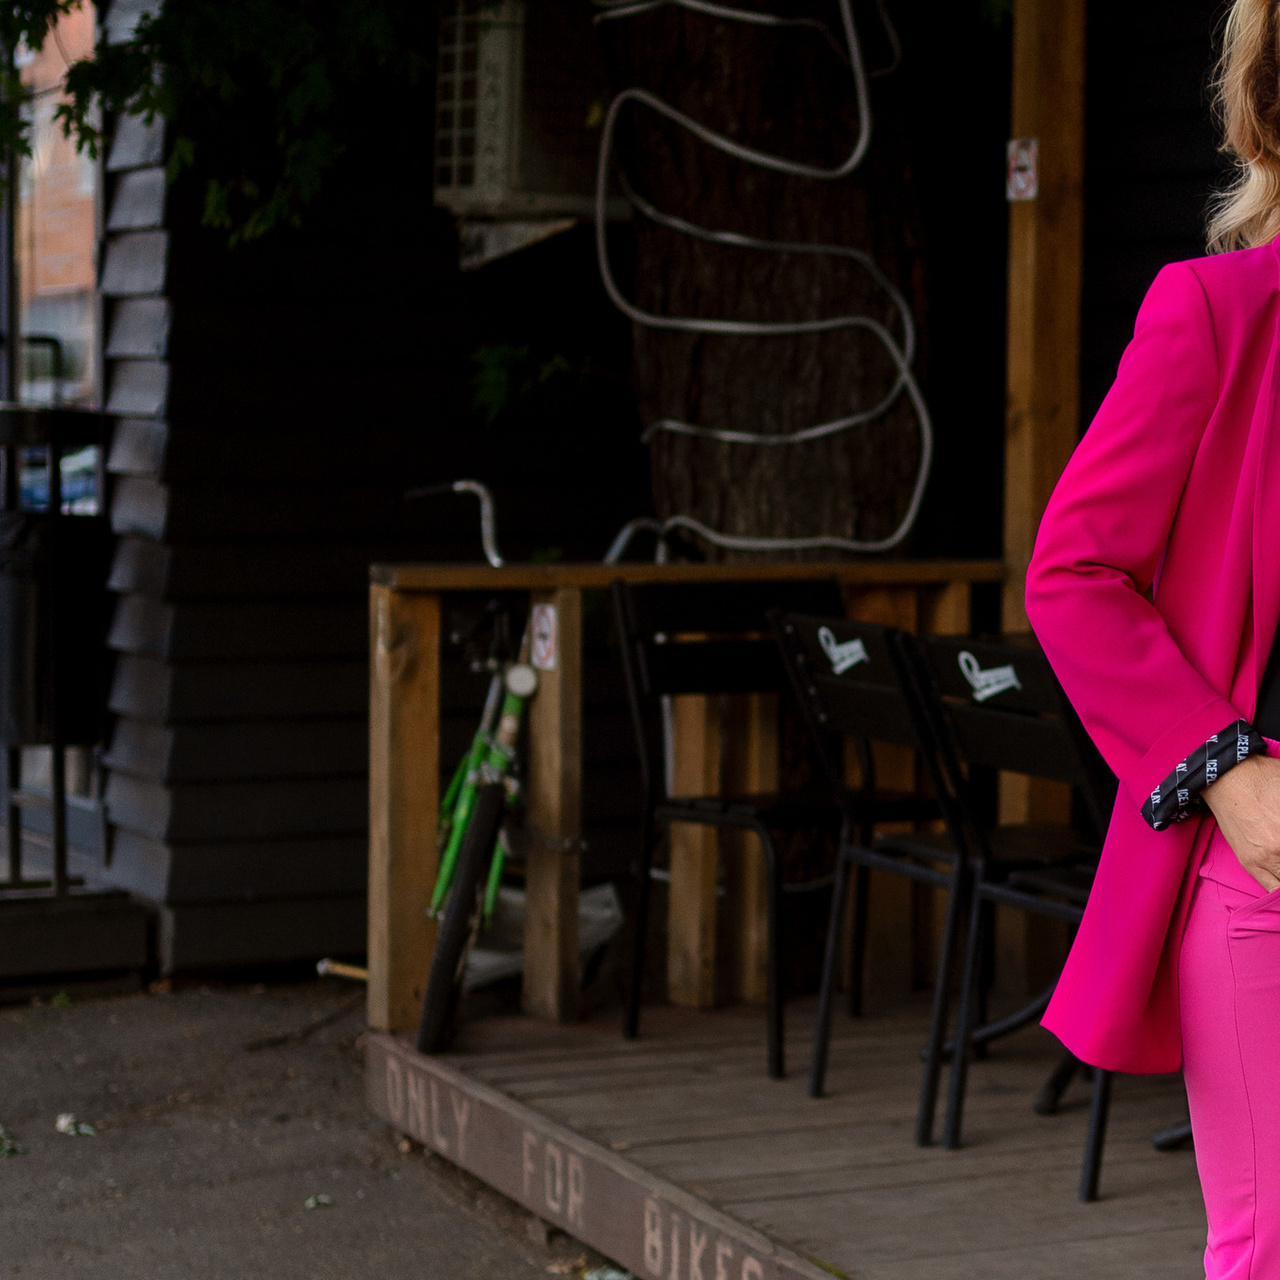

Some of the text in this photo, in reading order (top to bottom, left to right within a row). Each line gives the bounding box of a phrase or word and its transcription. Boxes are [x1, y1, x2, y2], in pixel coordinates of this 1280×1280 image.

[1206, 759, 1218, 773] ICE
[386, 1056, 469, 1163] ONLY
[523, 1130, 586, 1225] FOR
